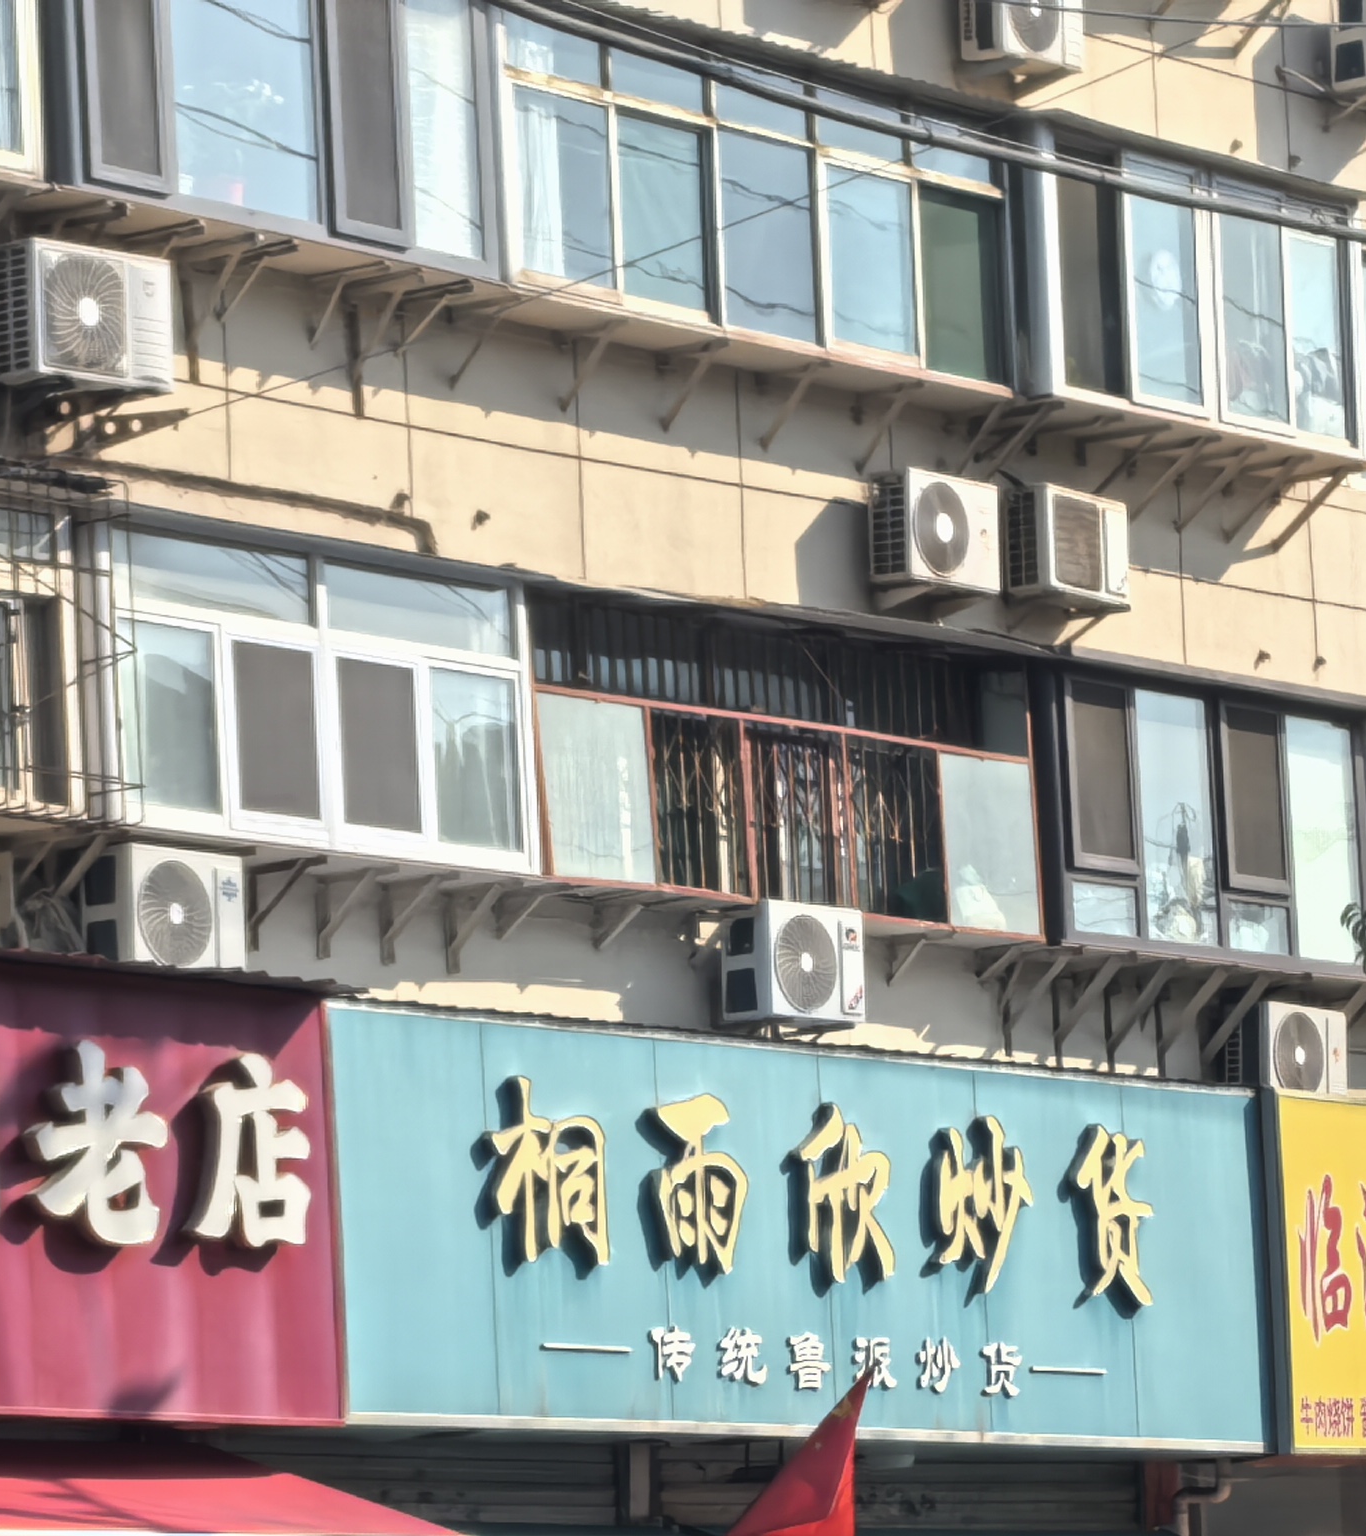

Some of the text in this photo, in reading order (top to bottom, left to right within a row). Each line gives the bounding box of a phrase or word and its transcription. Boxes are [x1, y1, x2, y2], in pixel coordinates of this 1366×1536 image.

[485, 1075, 1155, 1308] 桐雨欣炒货
[648, 1325, 1024, 1399] 传统鲁派炒货
